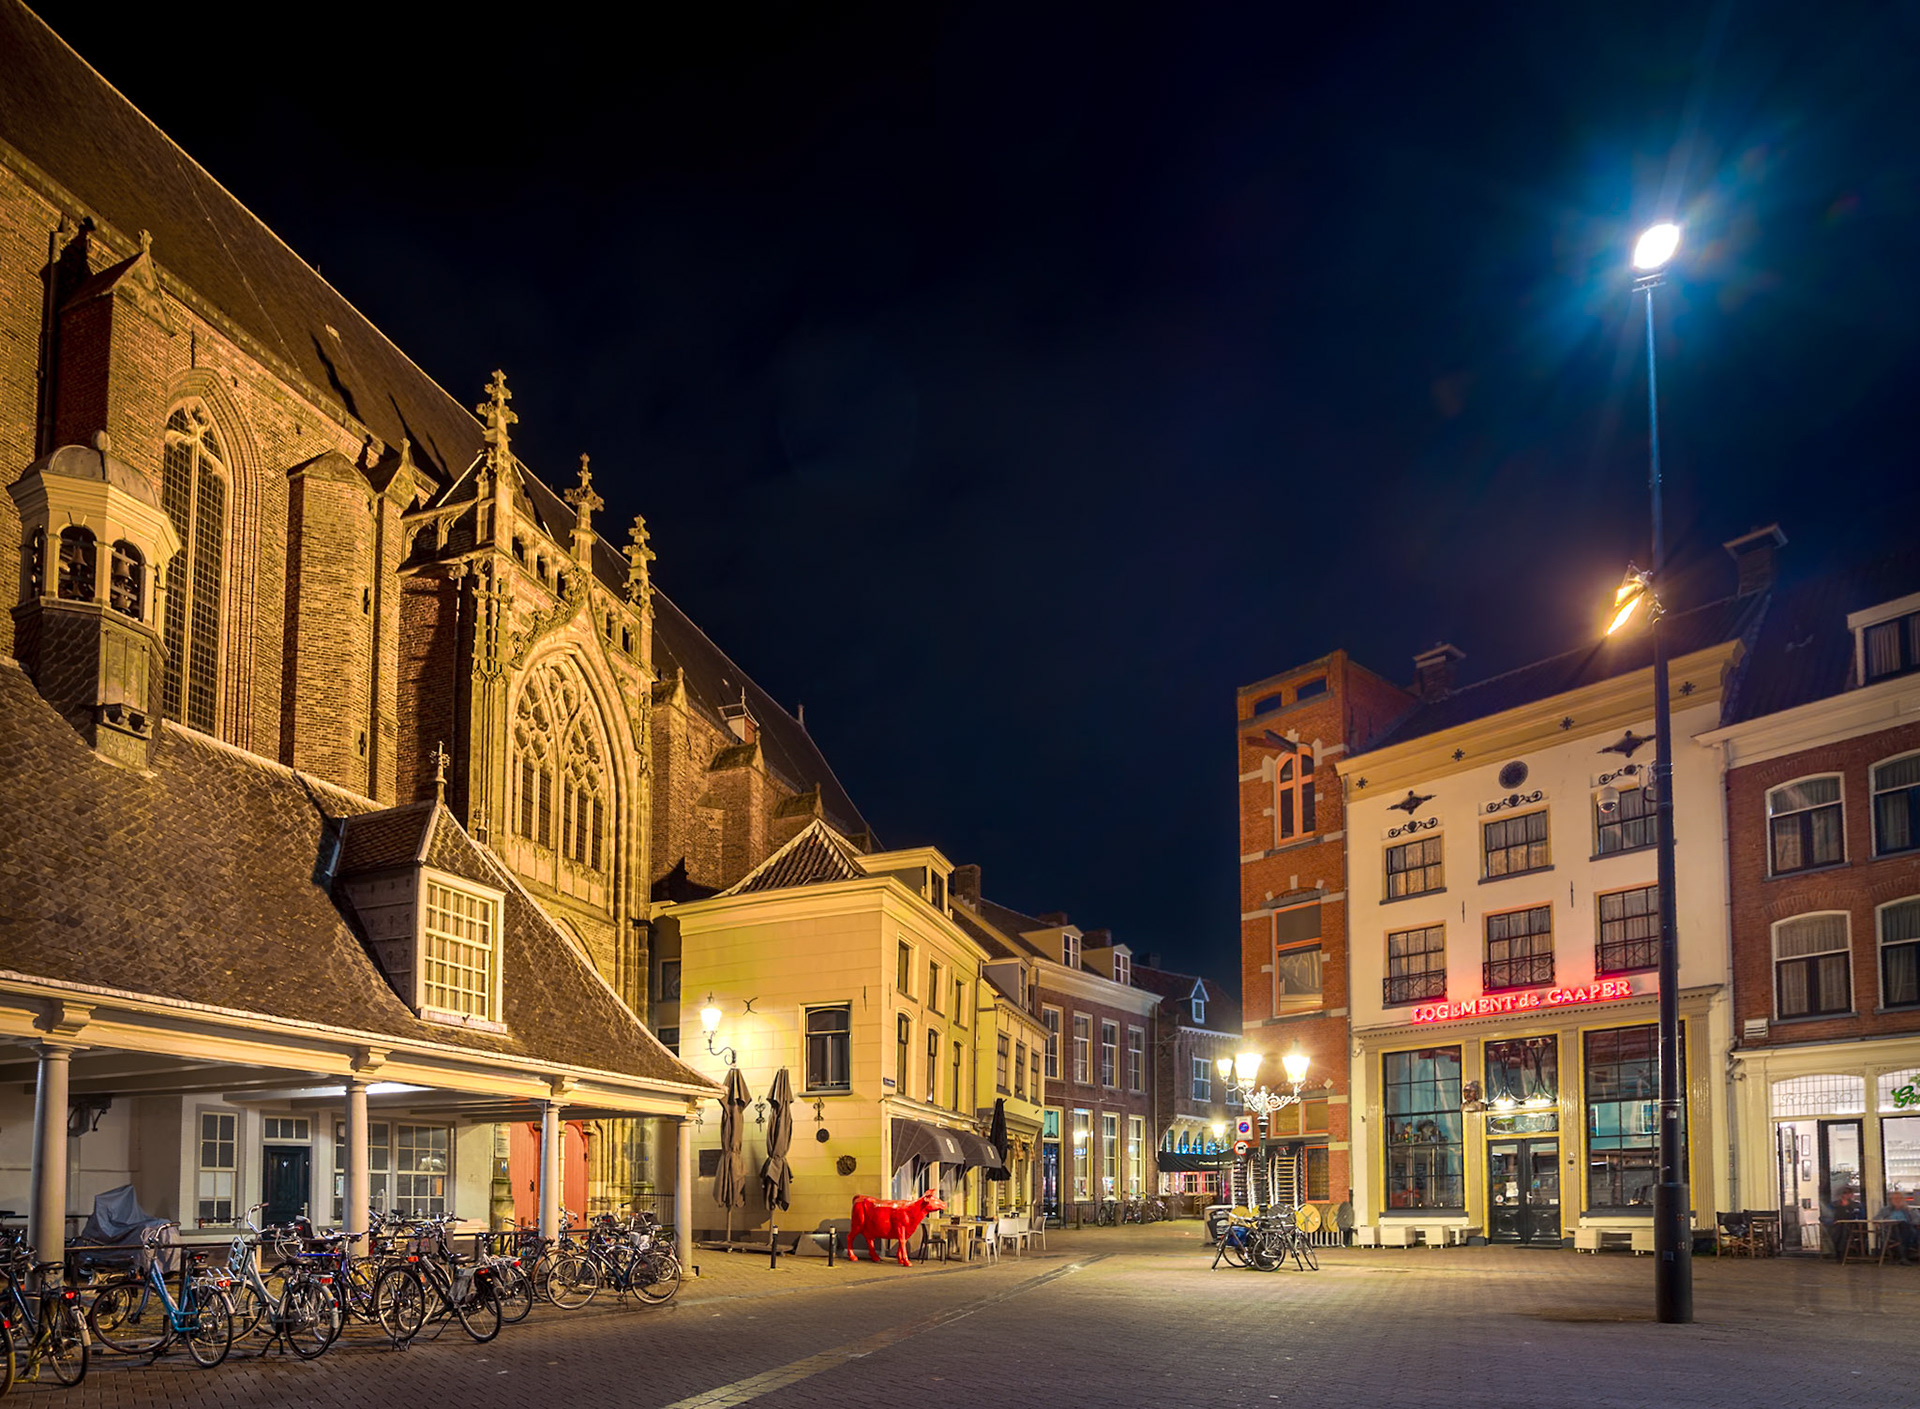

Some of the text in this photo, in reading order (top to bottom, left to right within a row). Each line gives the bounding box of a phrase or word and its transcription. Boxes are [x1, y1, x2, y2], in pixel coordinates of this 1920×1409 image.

[1413, 980, 1631, 1021] LOGEMENT de GAAPER
